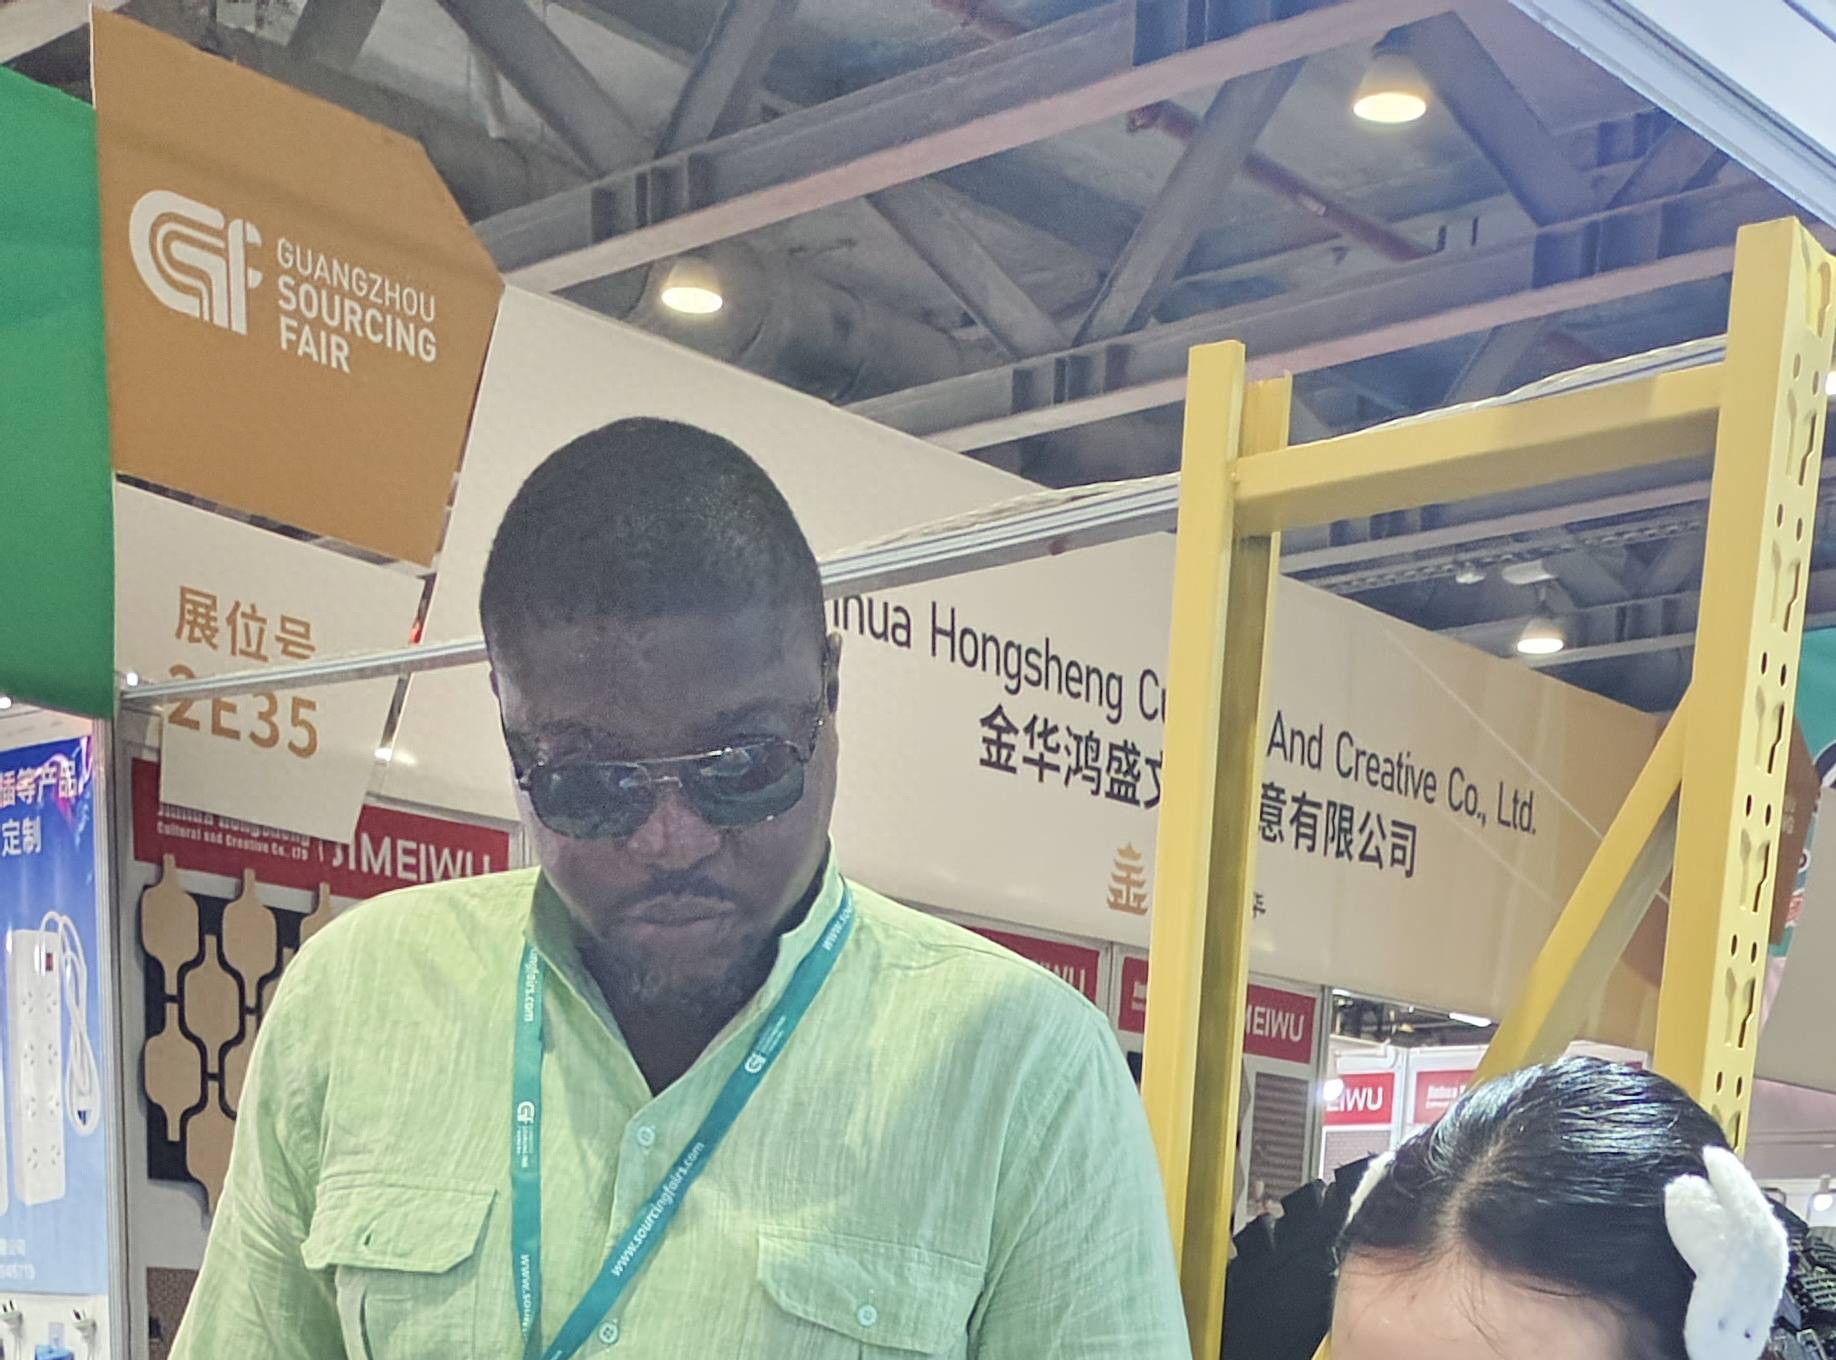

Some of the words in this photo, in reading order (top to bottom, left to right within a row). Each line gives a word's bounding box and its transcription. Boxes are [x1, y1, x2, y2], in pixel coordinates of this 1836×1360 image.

[276, 237, 436, 323] GUANGZHOU
[277, 274, 437, 363] SOURCING
[279, 314, 350, 374] FAIR
[174, 584, 317, 664] 展位号
[167, 664, 319, 759] 2E35
[931, 600, 1123, 725] Hongsheng
[1266, 709, 1324, 772] And
[1336, 731, 1437, 804] Creative
[1448, 766, 1487, 828] Co.,
[1497, 781, 1537, 836] Ltd.
[2, 817, 41, 857] 定制
[1258, 781, 1418, 879] 意有限公司
[611, 1142, 704, 1278] www.sourcingfairs.com
